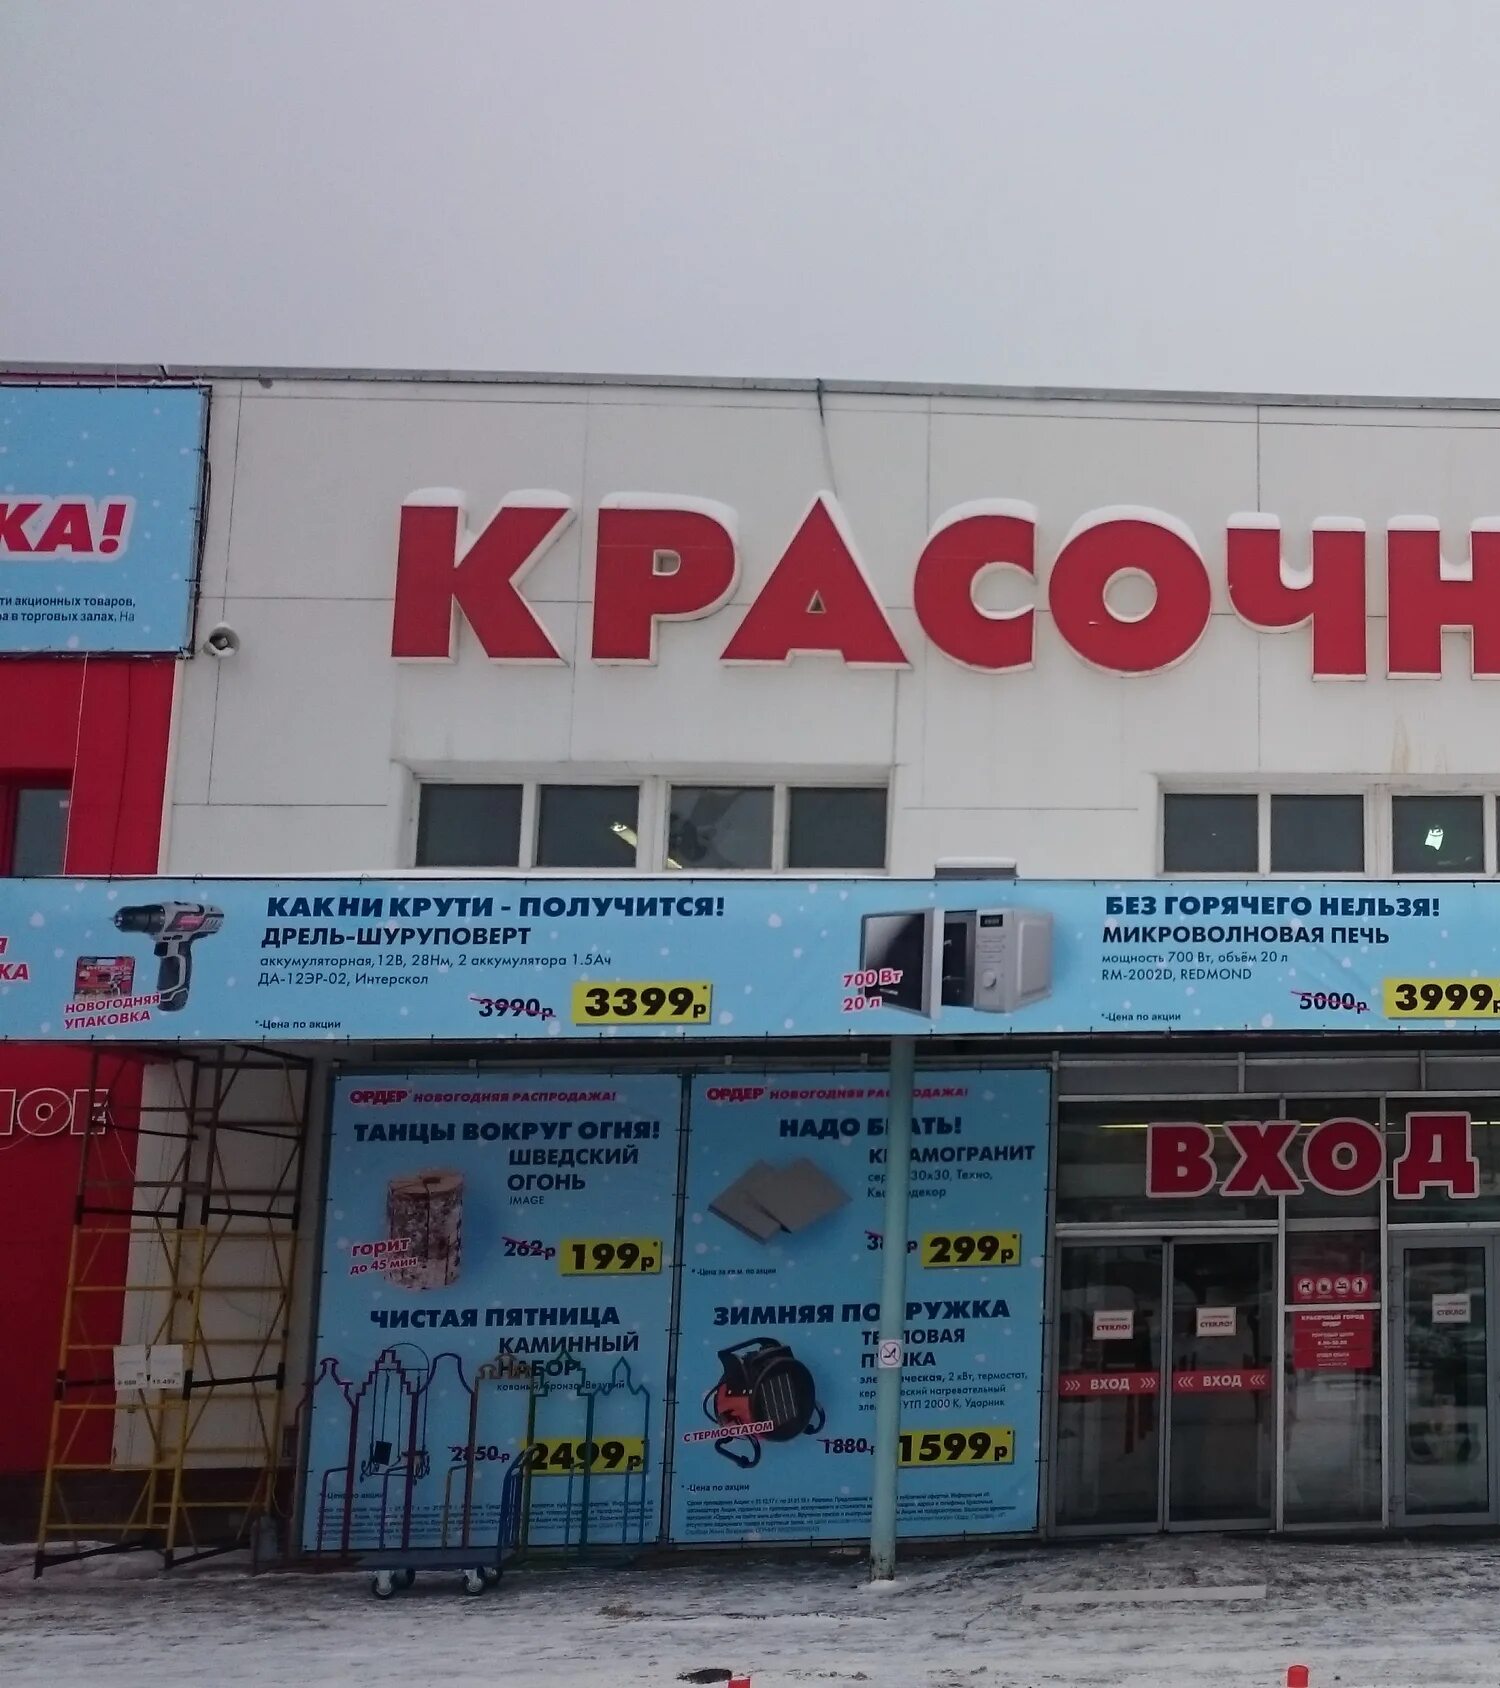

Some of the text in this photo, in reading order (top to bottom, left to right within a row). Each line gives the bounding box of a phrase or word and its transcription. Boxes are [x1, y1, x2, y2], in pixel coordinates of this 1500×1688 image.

[15, 598, 136, 608] акционных товаров,
[12, 611, 134, 623] в торговых залах. На
[267, 897, 725, 918] КАК НИ КРУТИ ПОЛУЧИТСЯ!
[1106, 897, 1440, 917] БЕЗ ГОРЯЧЕГО НЕЛЬЗЯ!
[261, 927, 531, 948] ДРЕЛЬ-ШУРУПОВЕРТ
[1102, 926, 1390, 944] МИКРОВОЛНОВАЯ ПЕЧЬ
[260, 953, 611, 968] аккумуляторная, 12В, 28Нм, 2 аккумулятора 1.5Ач
[1102, 950, 1288, 965] мощность 700 Вт, объём 20 л
[258, 971, 429, 987] ДА-12ЭР-02, Интерскол
[843, 969, 903, 988] 700 Вт
[1102, 968, 1252, 982] RM-2002D, REDMOND
[65, 993, 161, 1013] НОВОГОДНЯЯ
[842, 997, 864, 1011] 20
[64, 1011, 151, 1029] УПАКОВКА
[310, 1020, 341, 1029] акции
[1152, 1012, 1181, 1021] акции
[350, 1090, 616, 1105] ОРДЕР НОВОГОДНЯЯ РАСПРОДАЖА!
[706, 1087, 864, 1102] ОРДЕР НОВОГОДНЯЯ
[354, 1121, 660, 1144] ТАНЦЫ ВОКРУГ ОГНЯ!
[779, 1116, 962, 1138] НАДО БАТЬ!
[509, 1144, 639, 1167] ШВЕДСКИЙ
[869, 1145, 1036, 1164] КАМОГРАНИТ
[1147, 1112, 1479, 1198] ВХОД
[508, 1174, 586, 1191] ОГОНЬ
[956, 1169, 993, 1181] Техно,
[510, 1196, 545, 1205] IMAGE
[352, 1238, 411, 1258] горит
[350, 1257, 417, 1275] до 45 мин
[370, 1307, 620, 1329] ЧИСТАЯ ПЯТНИЦА
[713, 1300, 1010, 1326] ЗИМНЯЯ ПОРУЖКА
[1096, 1324, 1131, 1334] СТЕКЛО!
[1200, 1320, 1233, 1329] СТЕКЛО!
[499, 1331, 639, 1353] КАМИННЫЙ
[862, 1328, 965, 1346] ТЕЛОВАЯ
[499, 1359, 581, 1377] НАБОР
[948, 1373, 954, 1382] 2
[978, 1371, 1028, 1382] термостат,
[1090, 1378, 1130, 1391] ВХОД
[1203, 1375, 1242, 1388] ВХОД
[932, 1385, 1006, 1396] нагревательный
[924, 1398, 950, 1409] 2000
[965, 1398, 1005, 1409] Ударник
[683, 1421, 773, 1443] С ТЕРМОСТАТОМ
